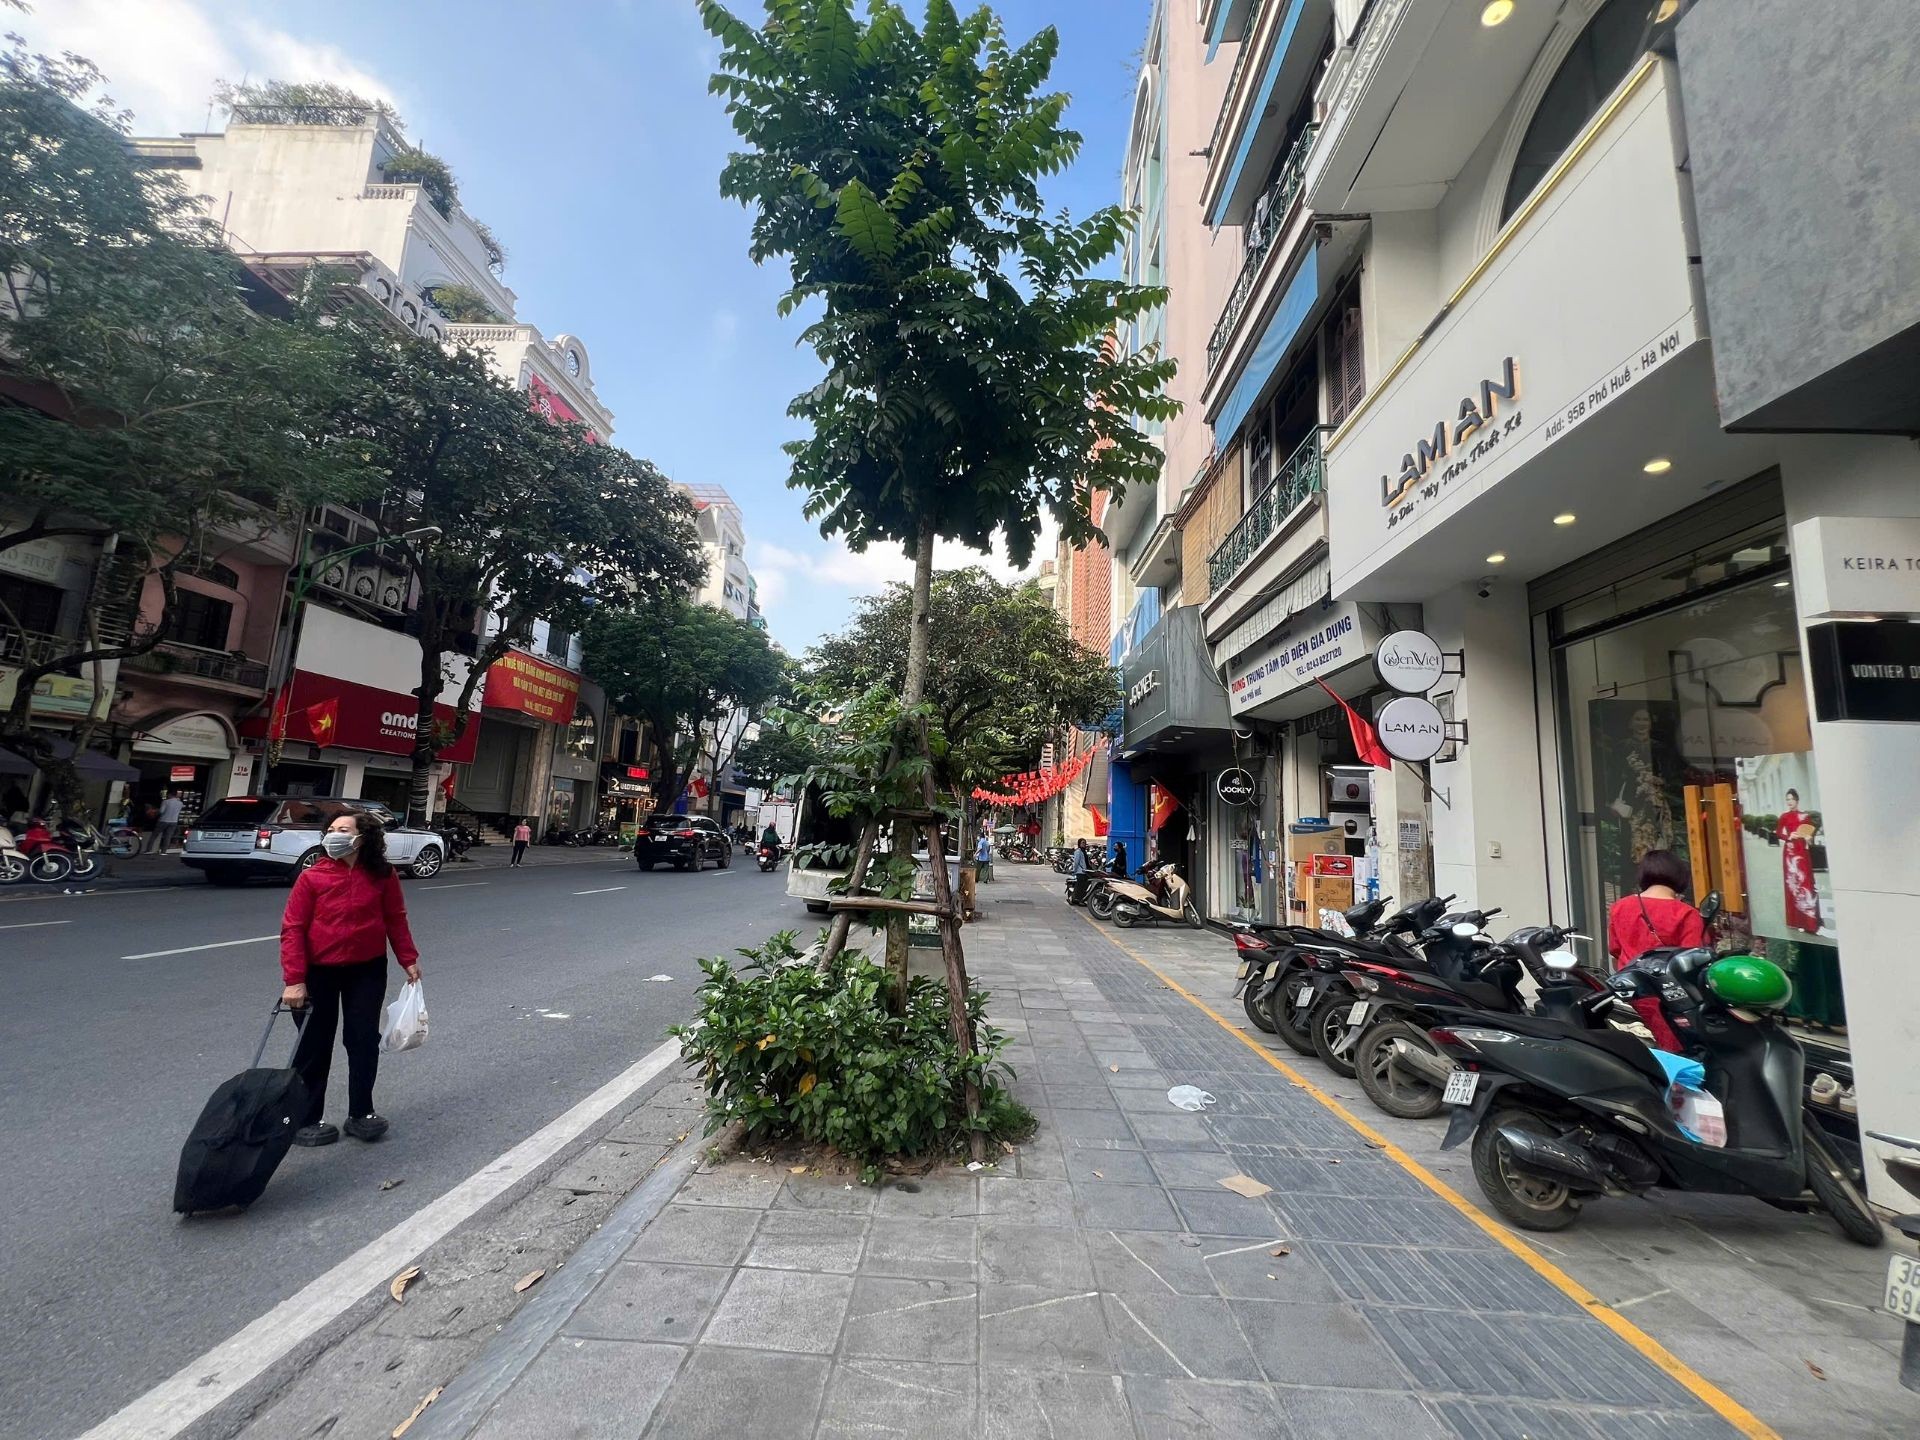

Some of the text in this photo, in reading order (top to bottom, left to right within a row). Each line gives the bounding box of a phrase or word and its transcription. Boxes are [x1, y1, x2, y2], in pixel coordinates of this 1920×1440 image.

[1545, 418, 1565, 441] Add:
[1567, 401, 1586, 424] 95B
[1641, 350, 1657, 370] Hà
[1843, 557, 1899, 570] KEIRA
[1310, 630, 1326, 651] GIA
[1325, 615, 1352, 642] DỤNG
[1851, 664, 1905, 679] VONTIER
[380, 728, 416, 739] CREATIONS
[1385, 723, 1439, 734] LAM AN
